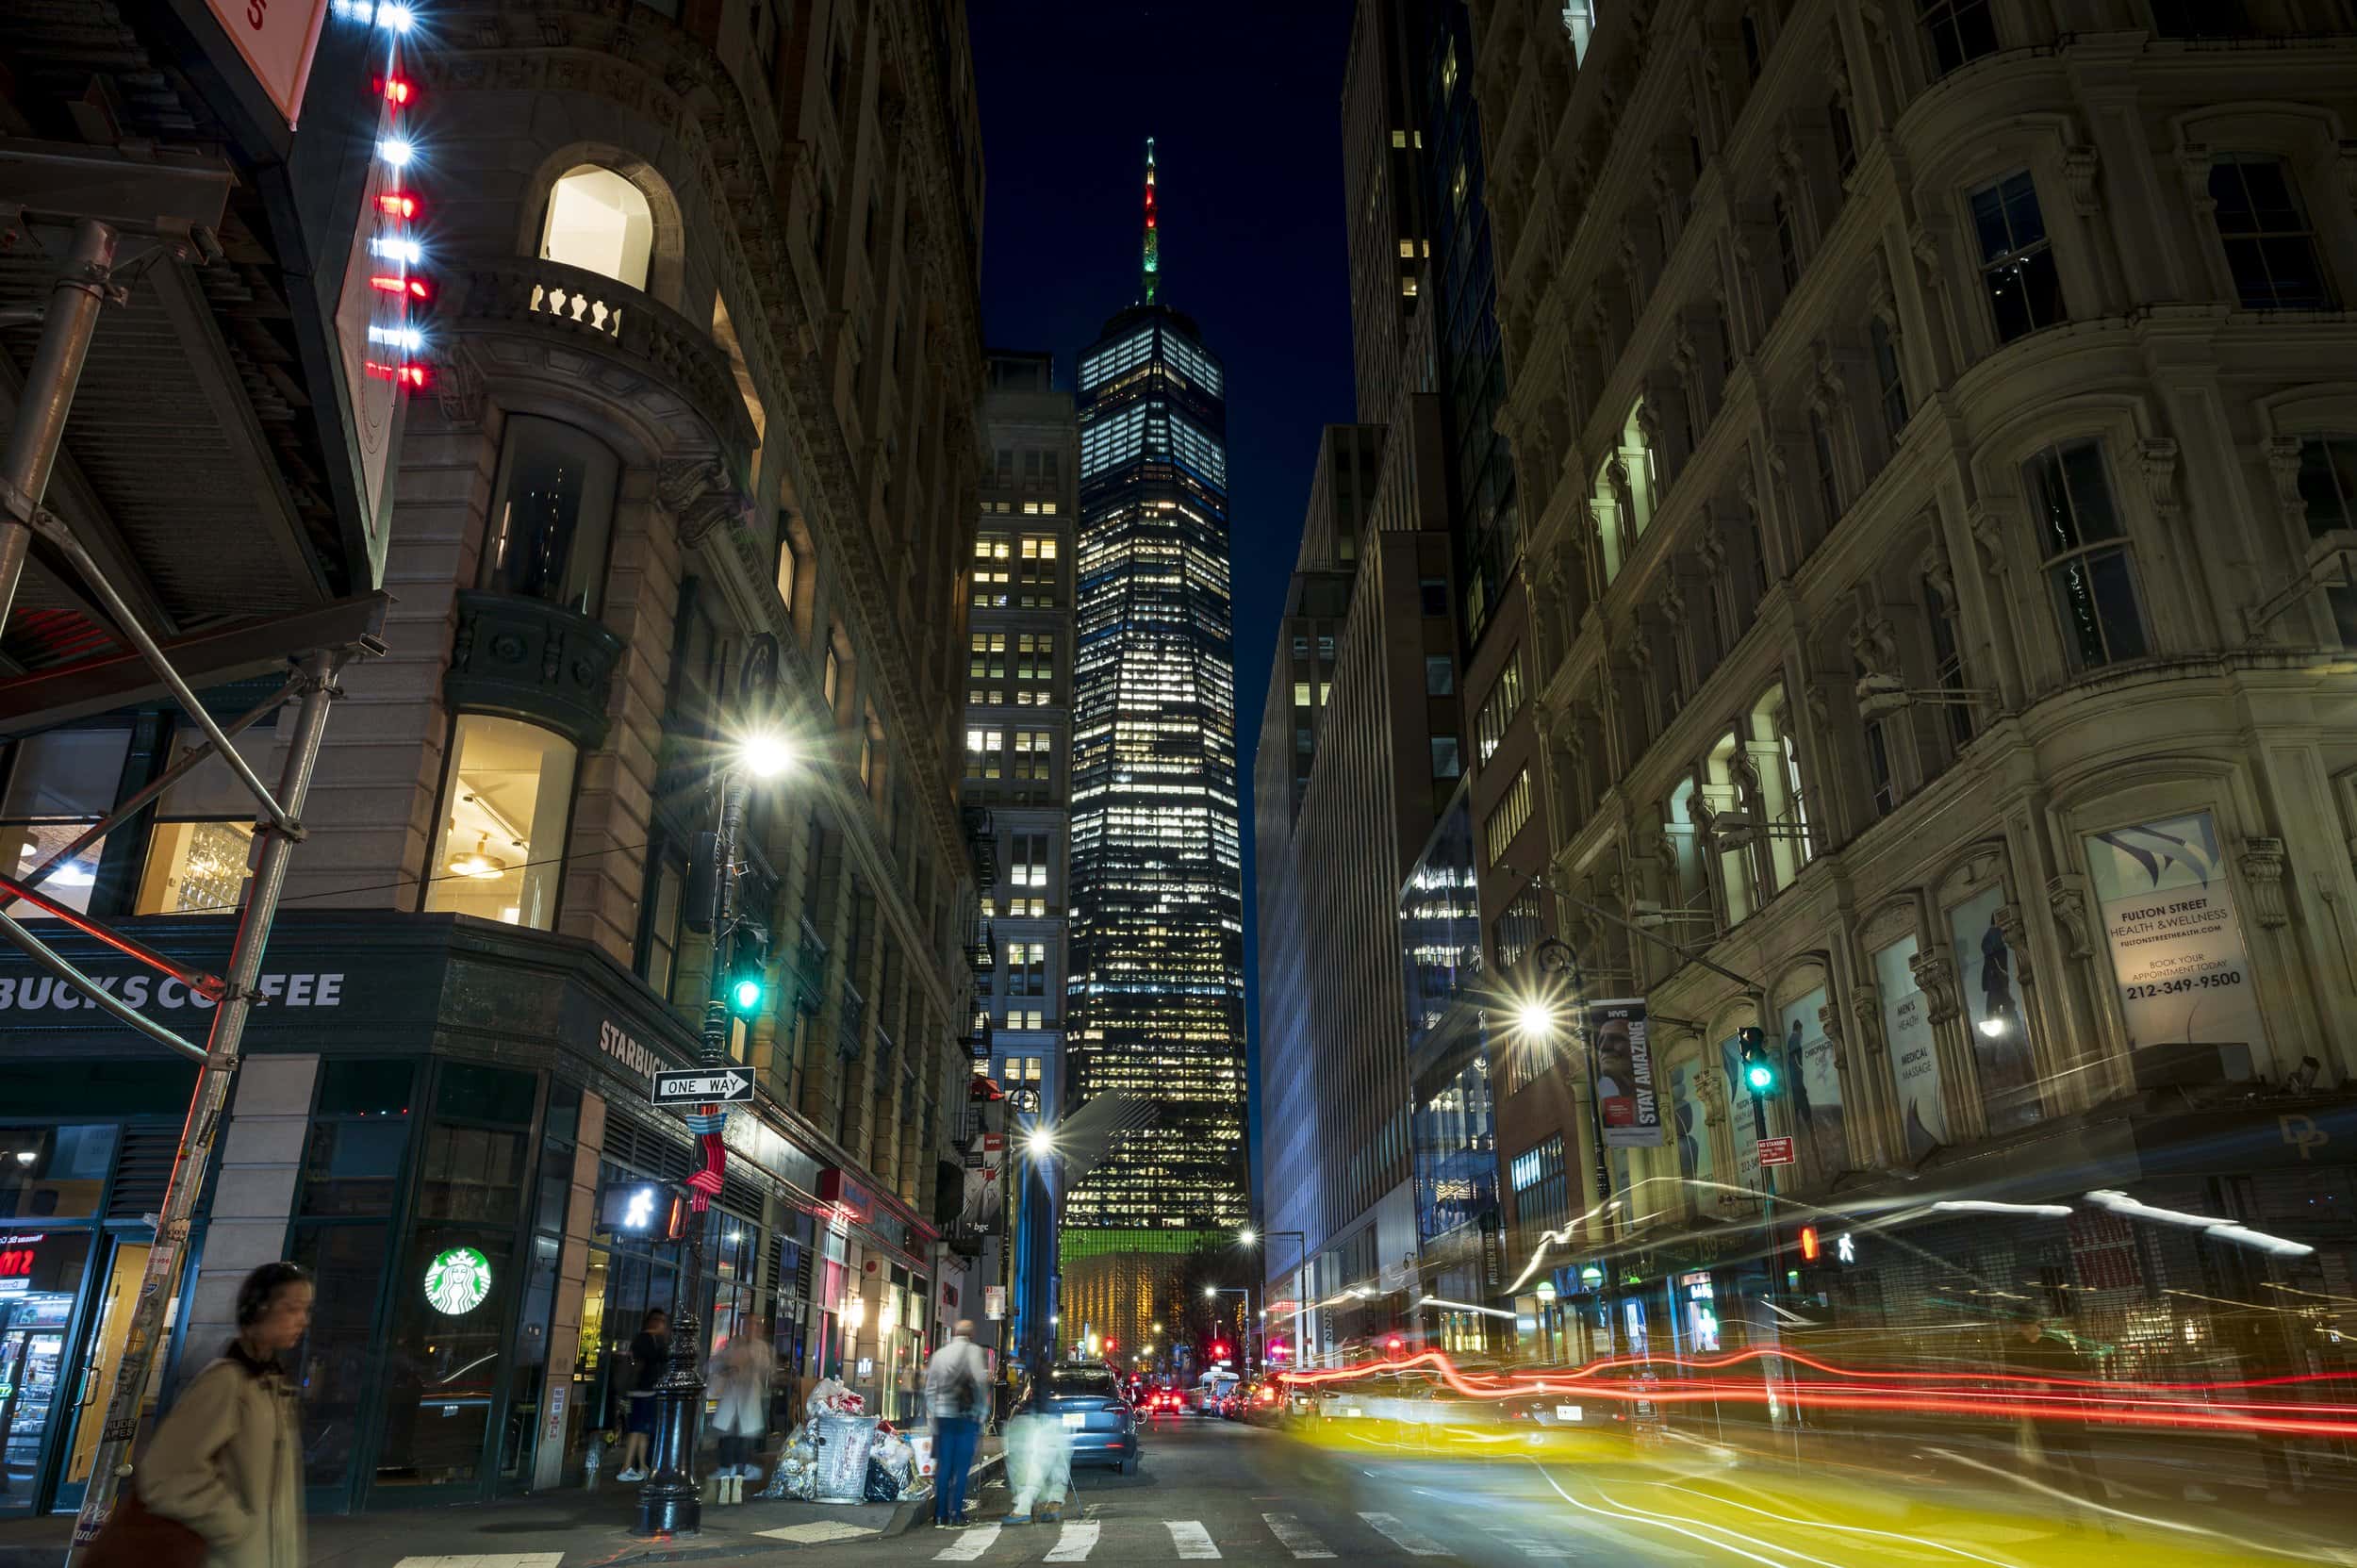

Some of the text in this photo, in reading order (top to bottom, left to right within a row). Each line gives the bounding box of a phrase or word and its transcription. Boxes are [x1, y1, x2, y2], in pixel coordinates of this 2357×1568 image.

[2121, 898, 2208, 923] FULTON STREET
[2110, 922, 2153, 938] HEALTH
[2166, 908, 2228, 927] WELLNESS
[2120, 925, 2222, 948] FULTONSTREETHEALTH.COM
[2133, 959, 2228, 982] APPOINTMENT TODAY
[2150, 953, 2204, 969] BOOK YOUR
[157, 973, 344, 1009] CFEE
[2126, 971, 2241, 1000] 212-349-9500
[1608, 1010, 1628, 1018] NYC
[600, 1019, 674, 1081] STARBUC
[1901, 1047, 1928, 1066] MEDICAL
[1628, 1020, 1656, 1125] STAY AMAZING
[668, 1078, 739, 1094] ONE WAY
